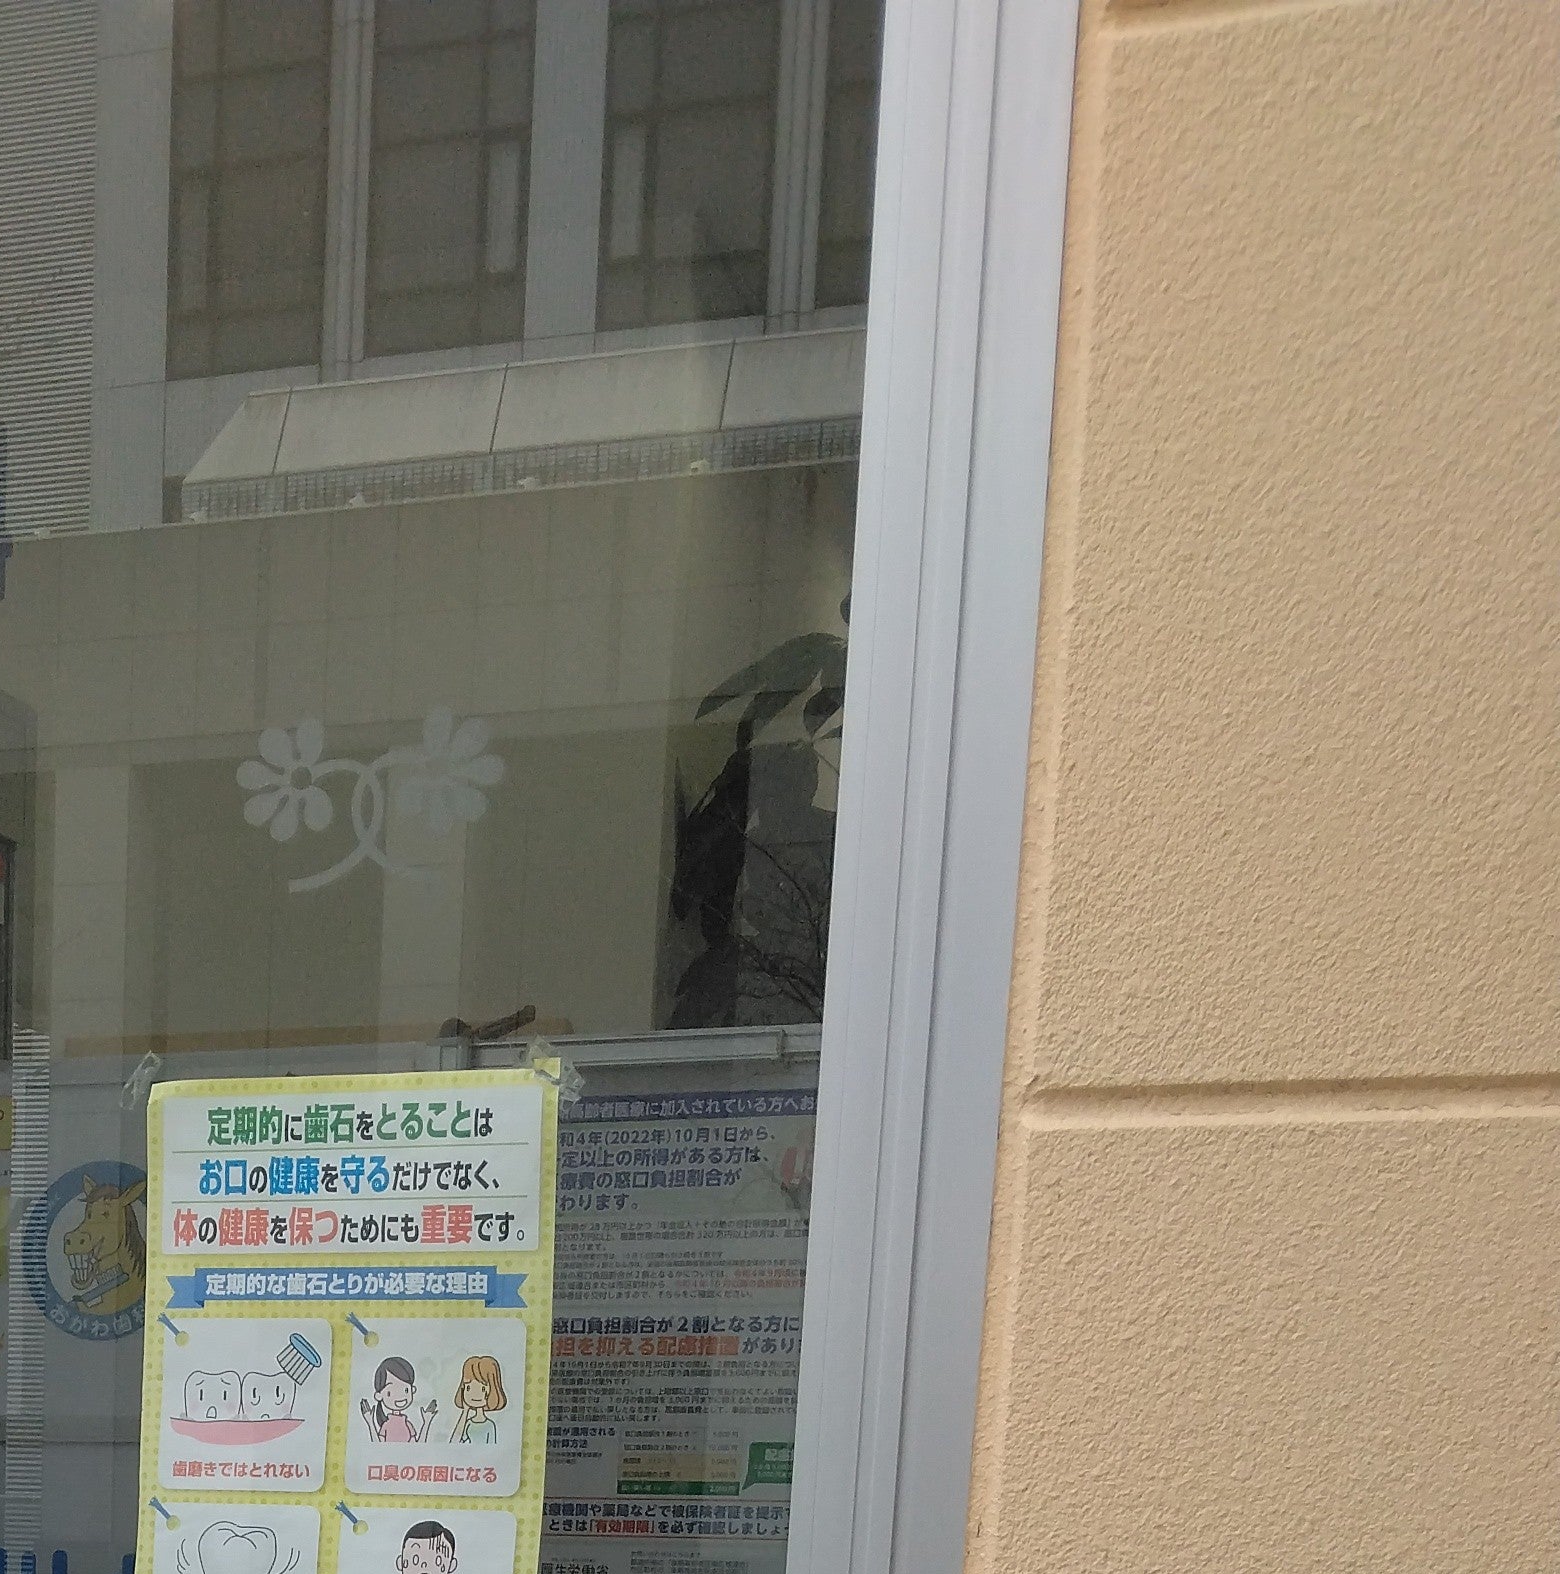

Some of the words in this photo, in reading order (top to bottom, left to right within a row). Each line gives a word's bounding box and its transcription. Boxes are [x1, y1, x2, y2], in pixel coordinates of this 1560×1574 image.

[207, 1100, 493, 1146] 定期的に歯石をとることは
[557, 1146, 768, 1168] 定以上の所得がある方は、
[199, 1154, 500, 1195] お口の健康を守るだけでなく、
[556, 1168, 742, 1191] 療費の窓口負担割合が
[556, 1193, 639, 1211] わります。
[173, 1204, 526, 1247] 体の健康を保つためにも重要です。
[206, 1271, 489, 1297] 定期的な歯石とりが必要な理由
[172, 1461, 310, 1479] 歯磨きではとれない
[367, 1464, 497, 1483] 口臭の原因になる
